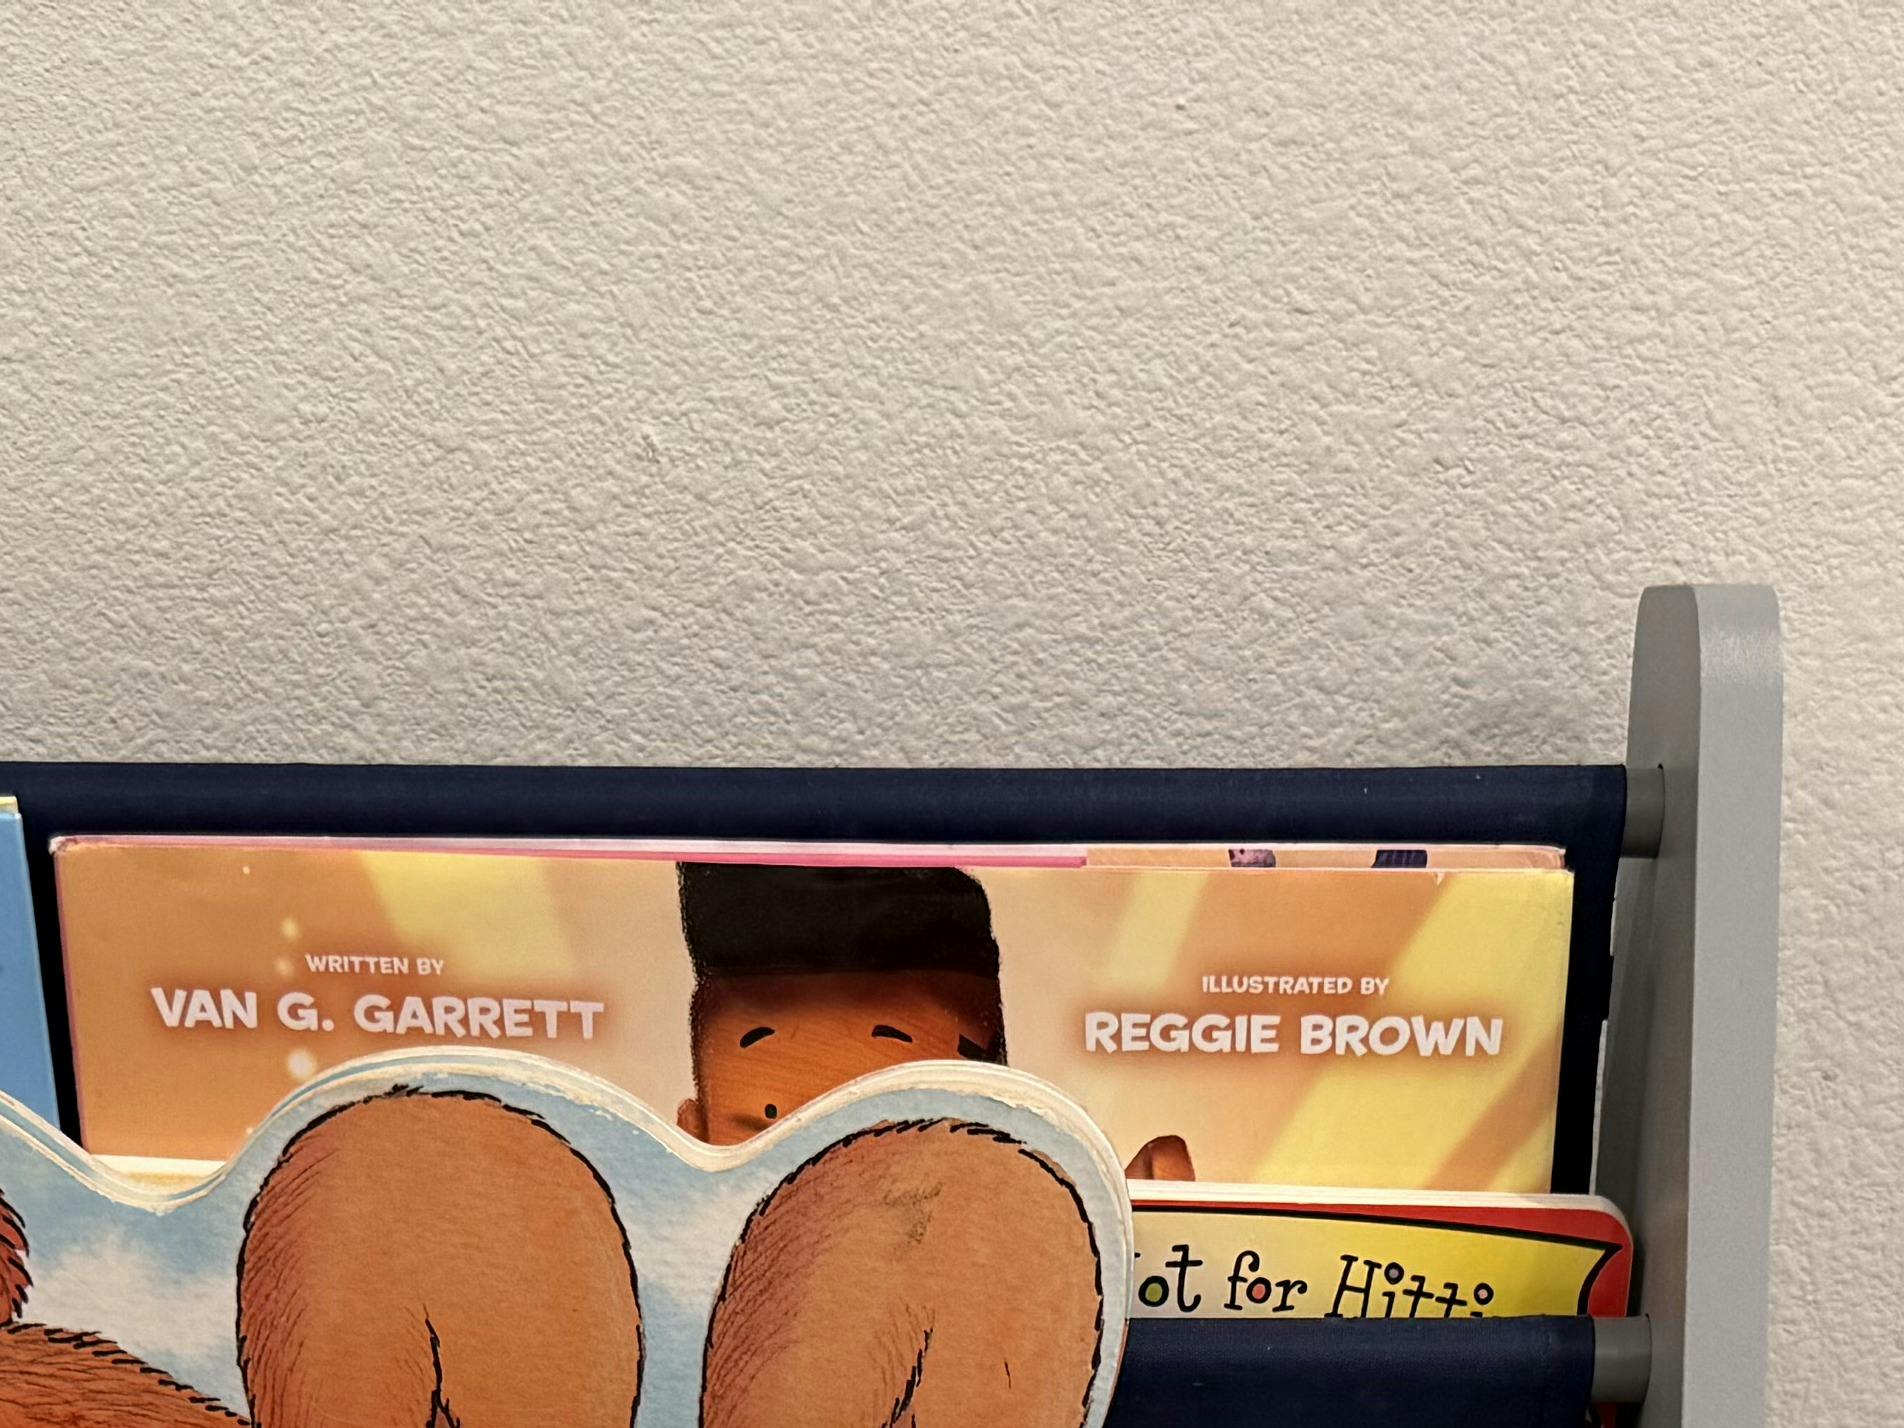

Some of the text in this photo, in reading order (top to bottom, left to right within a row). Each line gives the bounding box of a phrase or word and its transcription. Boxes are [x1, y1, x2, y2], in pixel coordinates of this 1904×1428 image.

[304, 953, 445, 976] WRITTEN BY
[1201, 974, 1390, 998] ILLUSTRATED BY
[150, 986, 605, 1040] VAN G. GARRETT
[1084, 1012, 1504, 1057] REGGIE BROWN
[1132, 1244, 1203, 1313] ot
[1224, 1249, 1308, 1312] for
